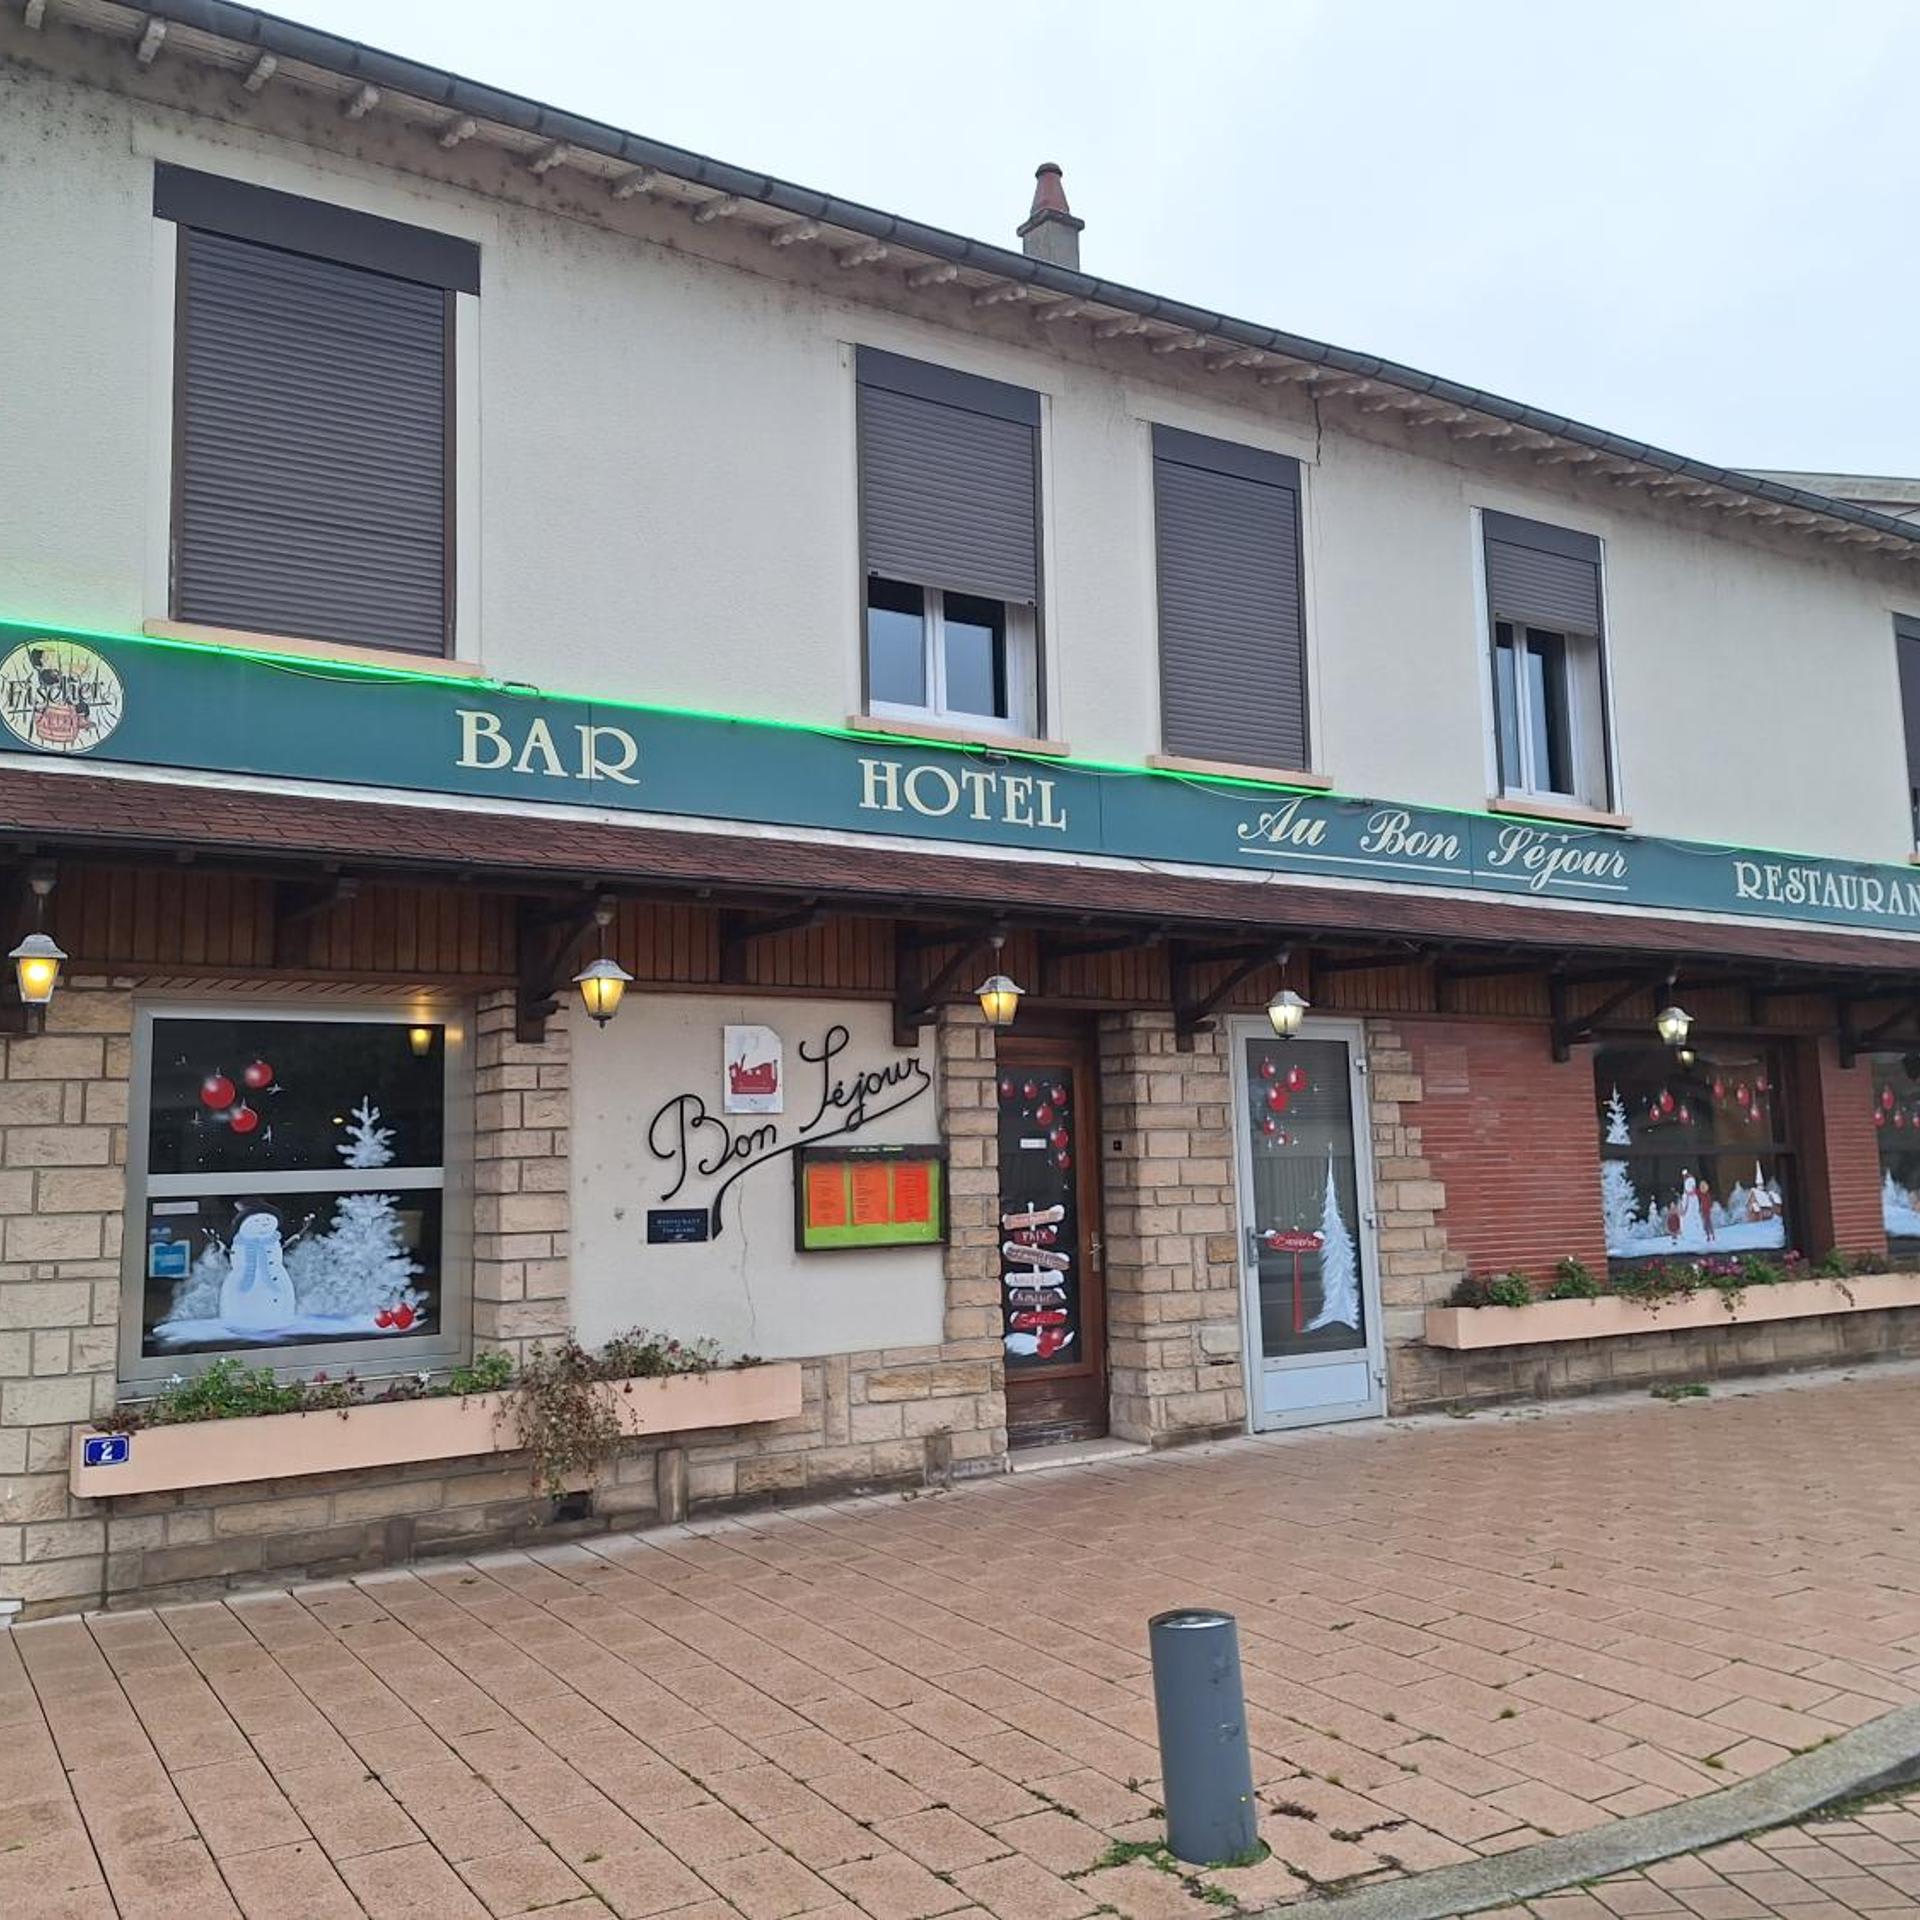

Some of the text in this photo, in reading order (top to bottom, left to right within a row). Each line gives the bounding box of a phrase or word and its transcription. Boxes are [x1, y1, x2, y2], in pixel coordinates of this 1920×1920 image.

[455, 709, 640, 785] BAR
[858, 758, 1067, 832] HOTEL
[1237, 797, 1628, 891] Au Bon Séjour
[649, 1093, 777, 1202] Bon
[101, 1441, 113, 1460] 2
